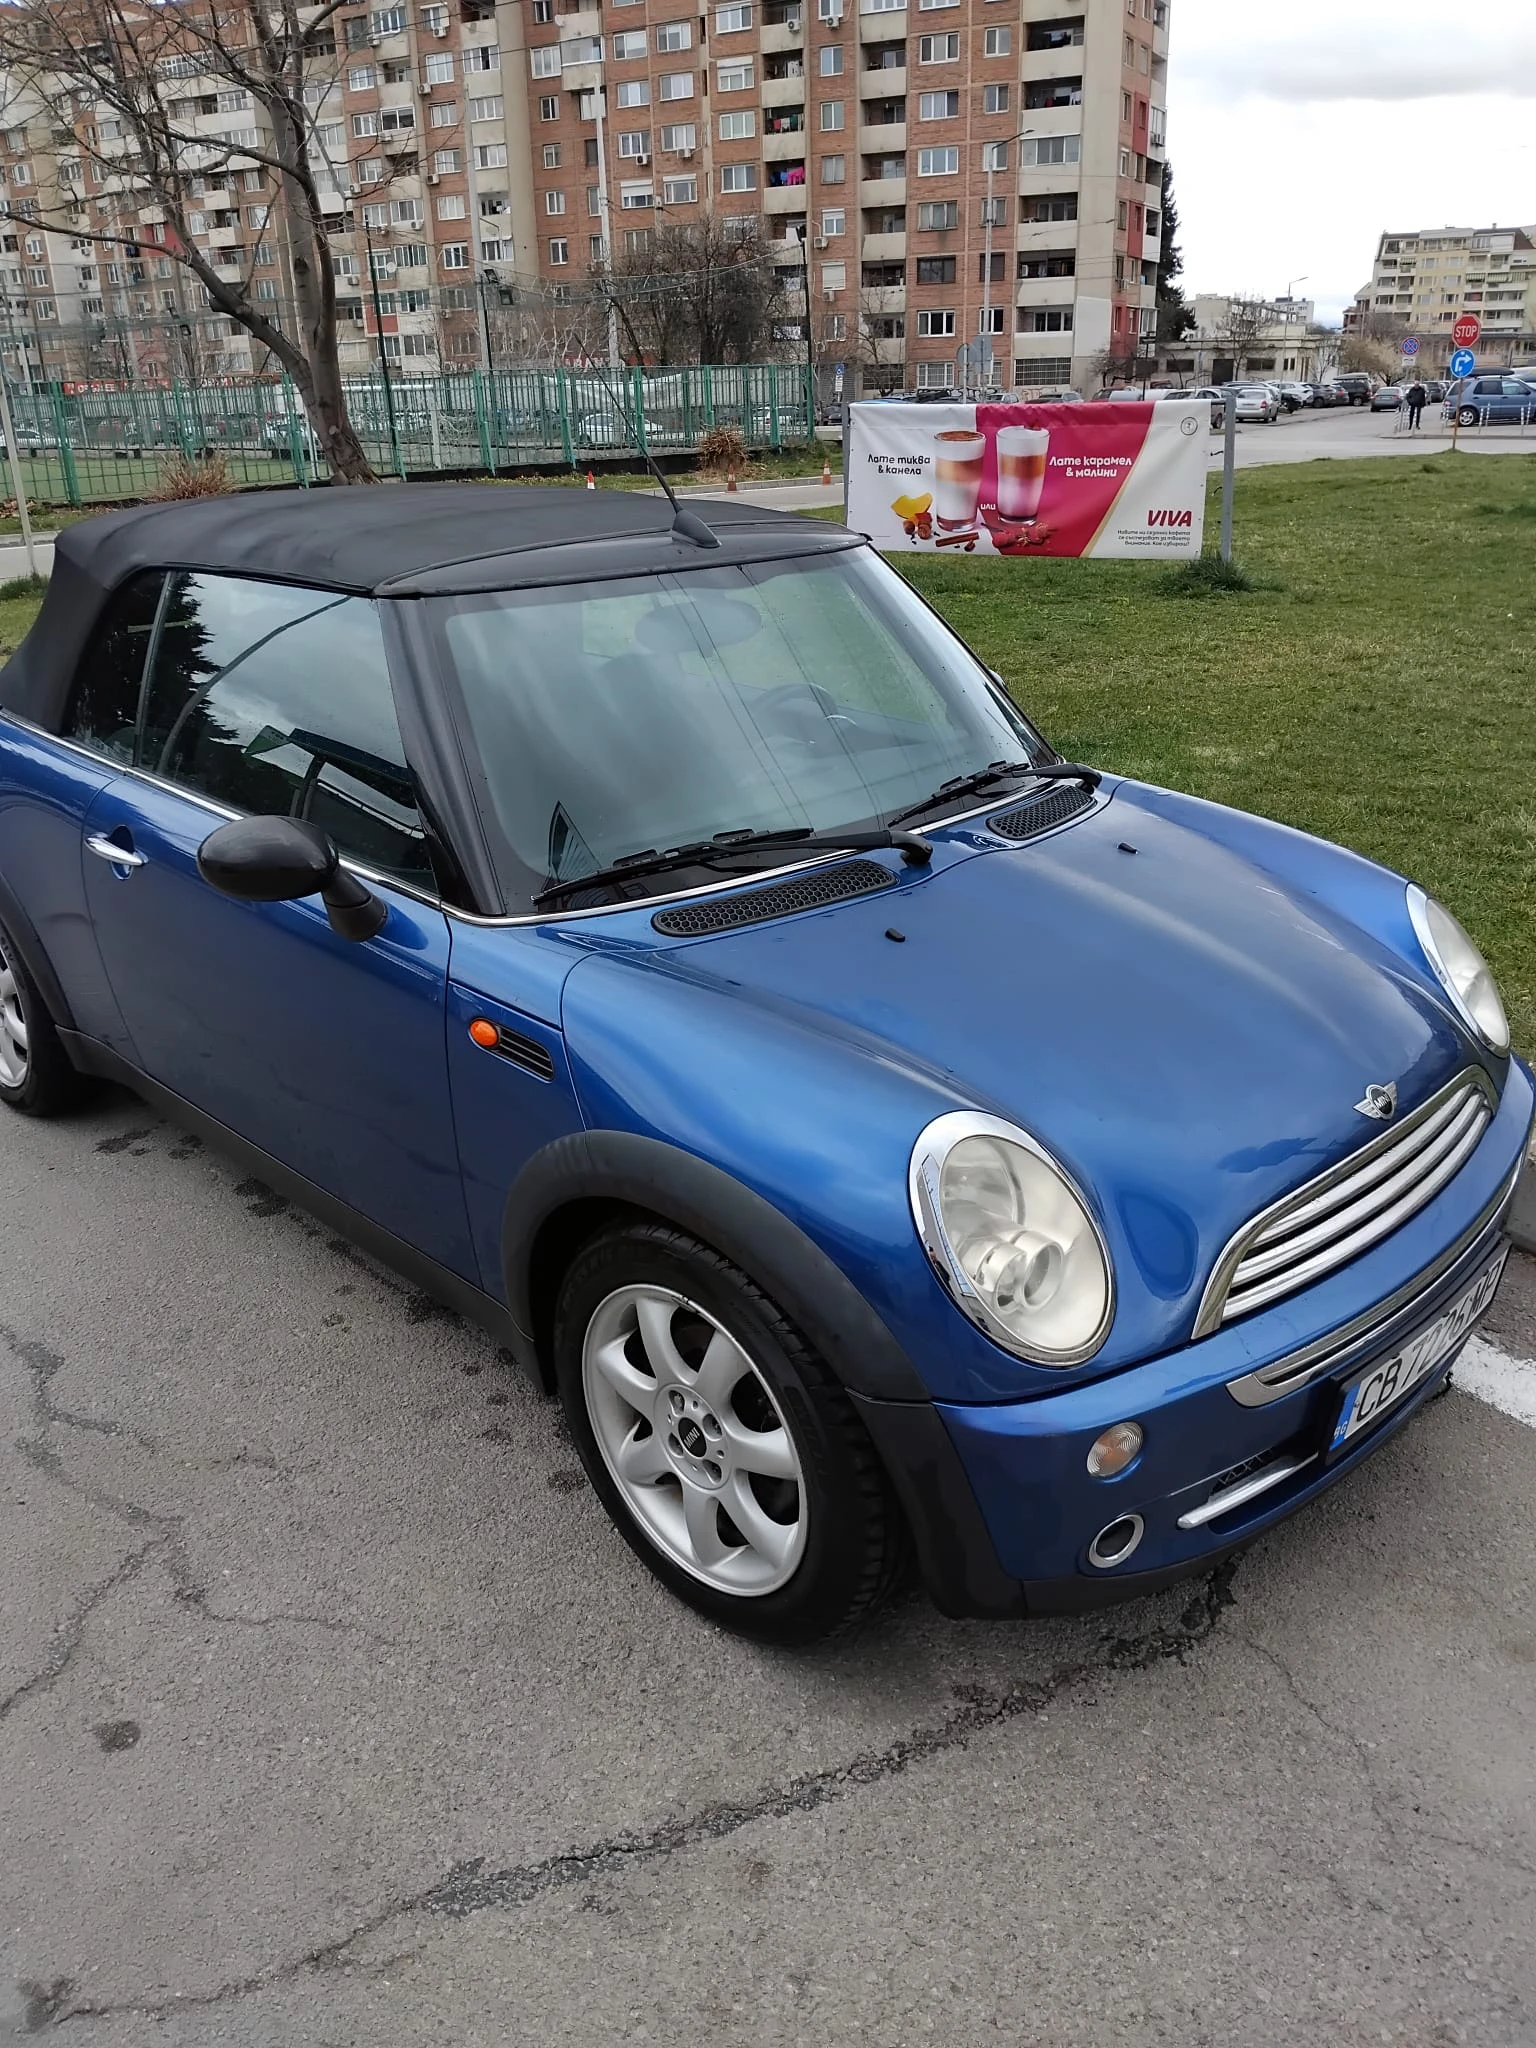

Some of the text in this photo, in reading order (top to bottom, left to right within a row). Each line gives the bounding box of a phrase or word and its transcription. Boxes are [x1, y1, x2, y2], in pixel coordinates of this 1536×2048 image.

[1455, 325, 1478, 338] STOP
[867, 453, 931, 465] Лате тиква
[1049, 456, 1132, 468] Лате карамел
[878, 464, 922, 475] & канела
[1065, 466, 1118, 478] & малини
[1147, 510, 1192, 527] VIVA
[1357, 1358, 1402, 1422] CB
[1333, 1421, 1348, 1440] BG
[683, 1426, 700, 1449] MINI
